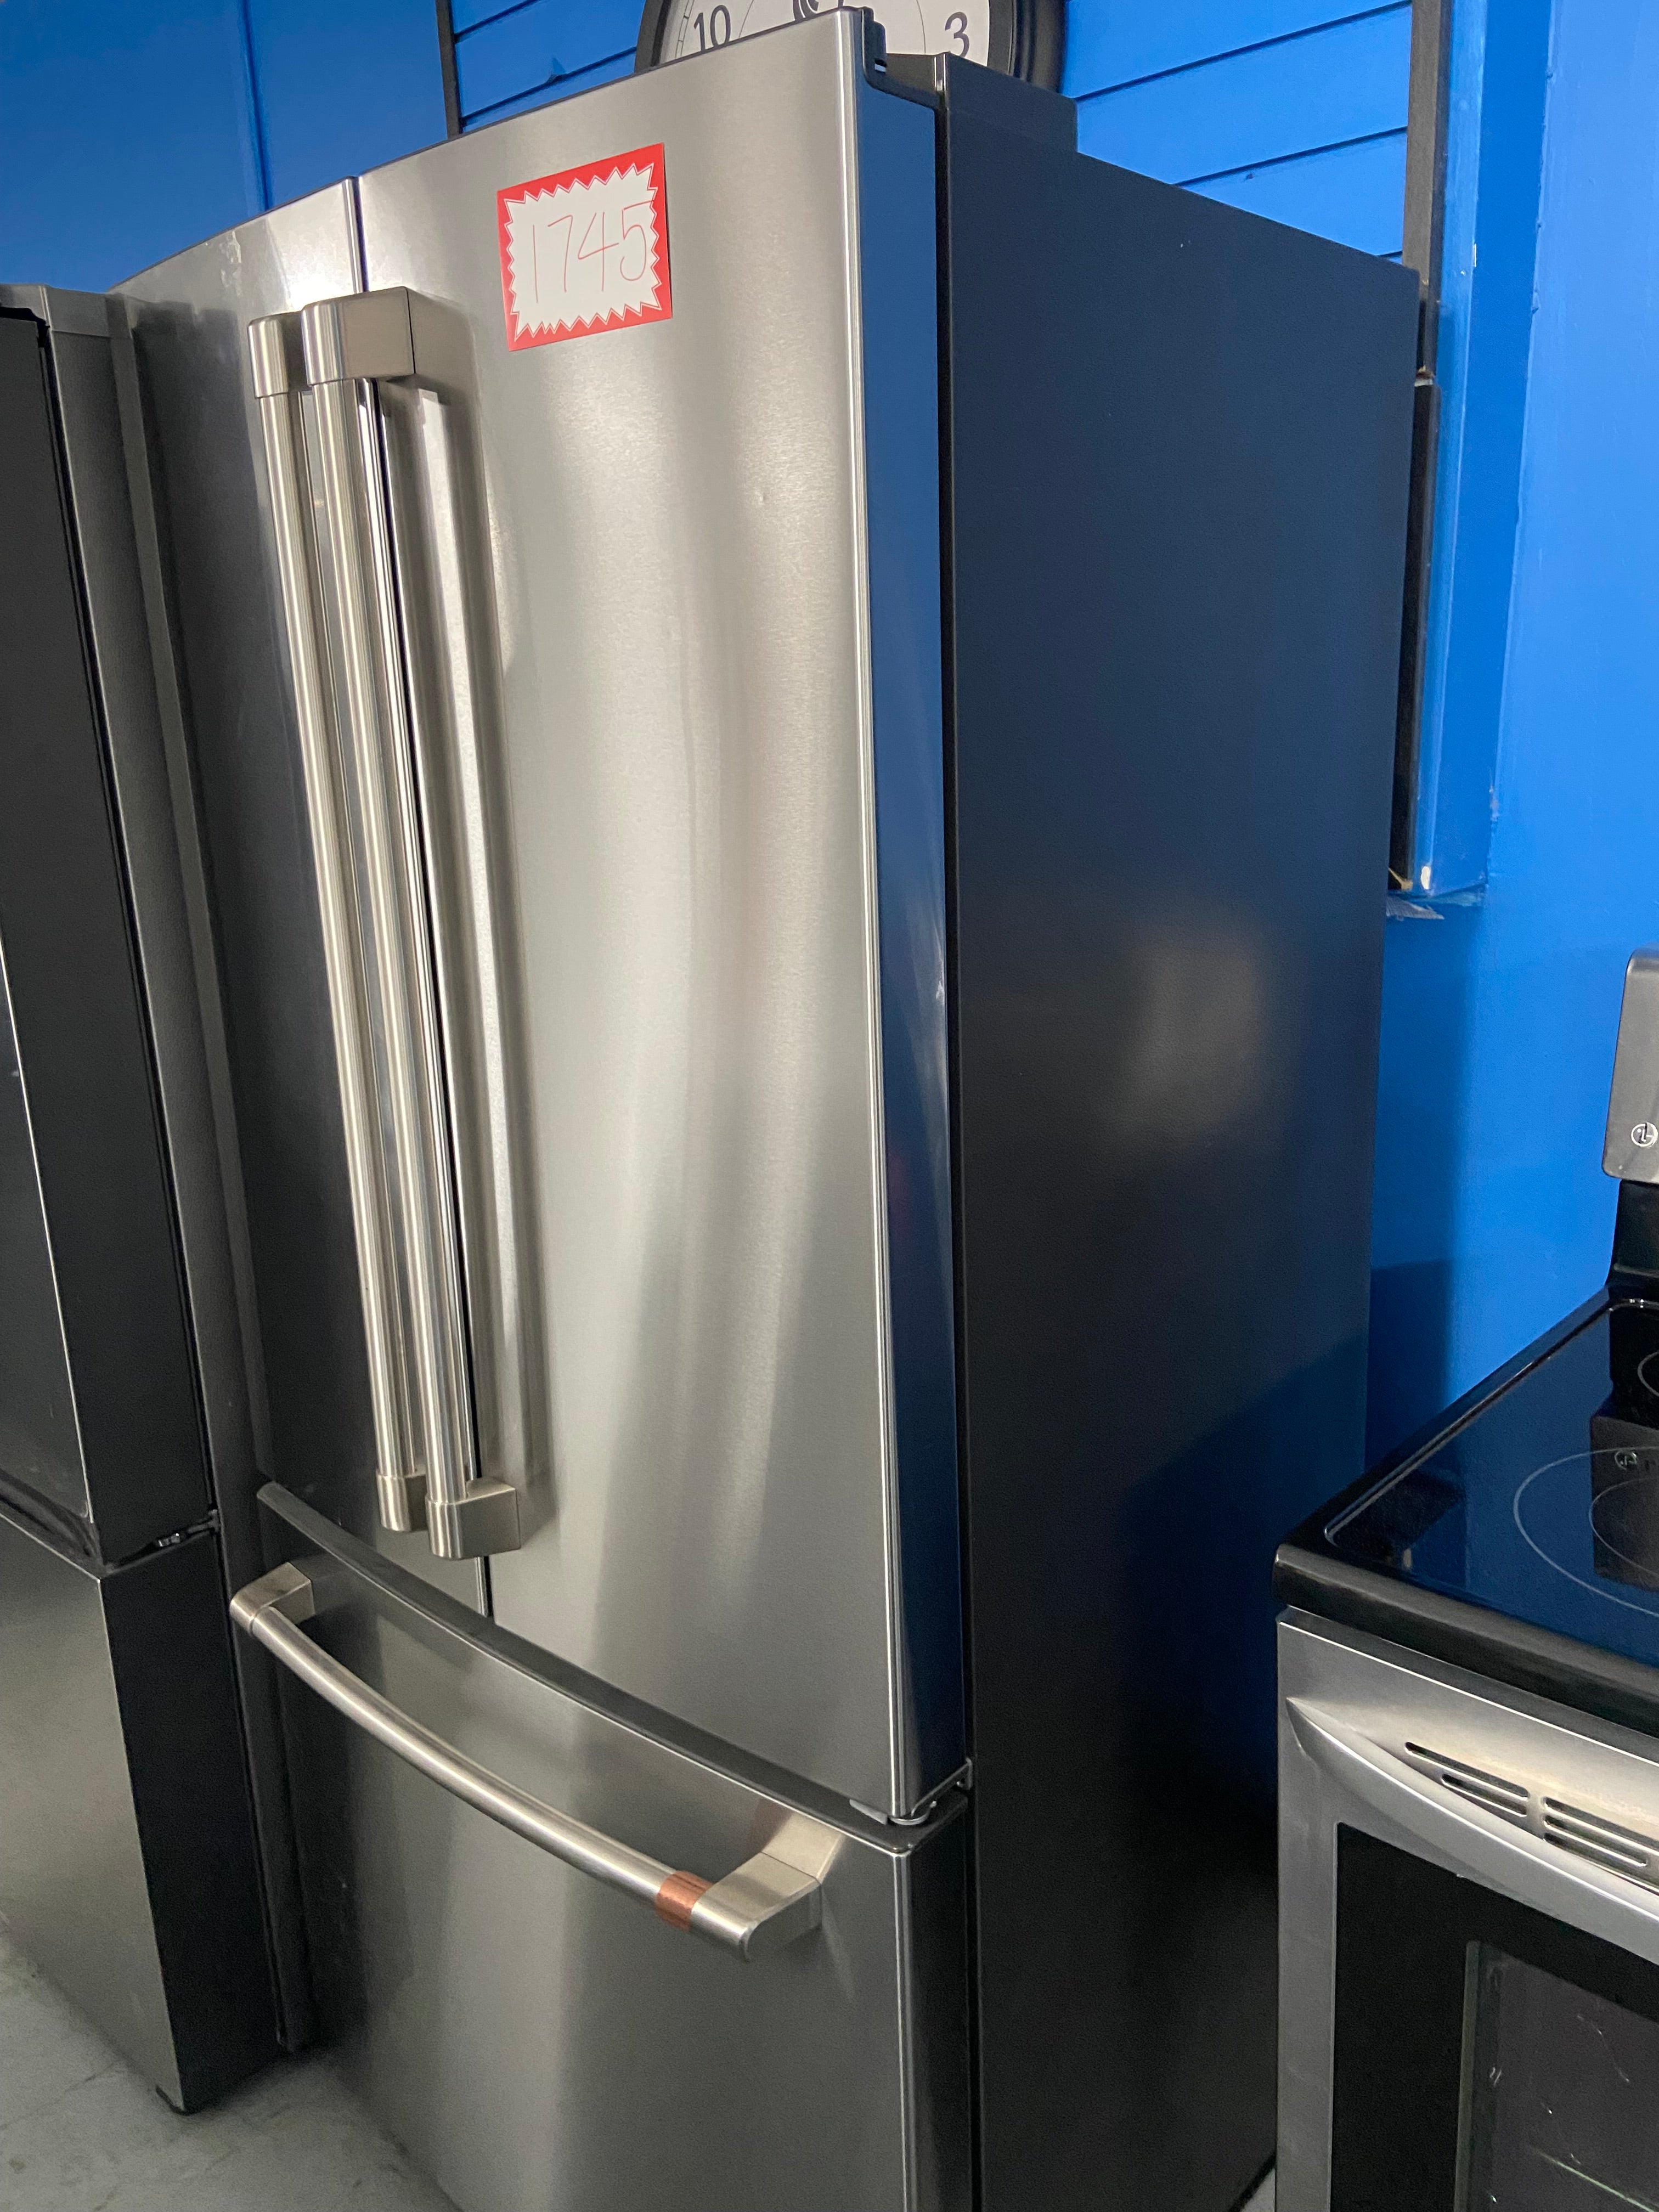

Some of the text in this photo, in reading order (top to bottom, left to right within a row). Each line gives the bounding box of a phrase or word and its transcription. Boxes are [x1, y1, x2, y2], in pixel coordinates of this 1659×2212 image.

[693, 4, 731, 52] 10
[945, 12, 970, 58] 3
[532, 199, 654, 303] 1745
